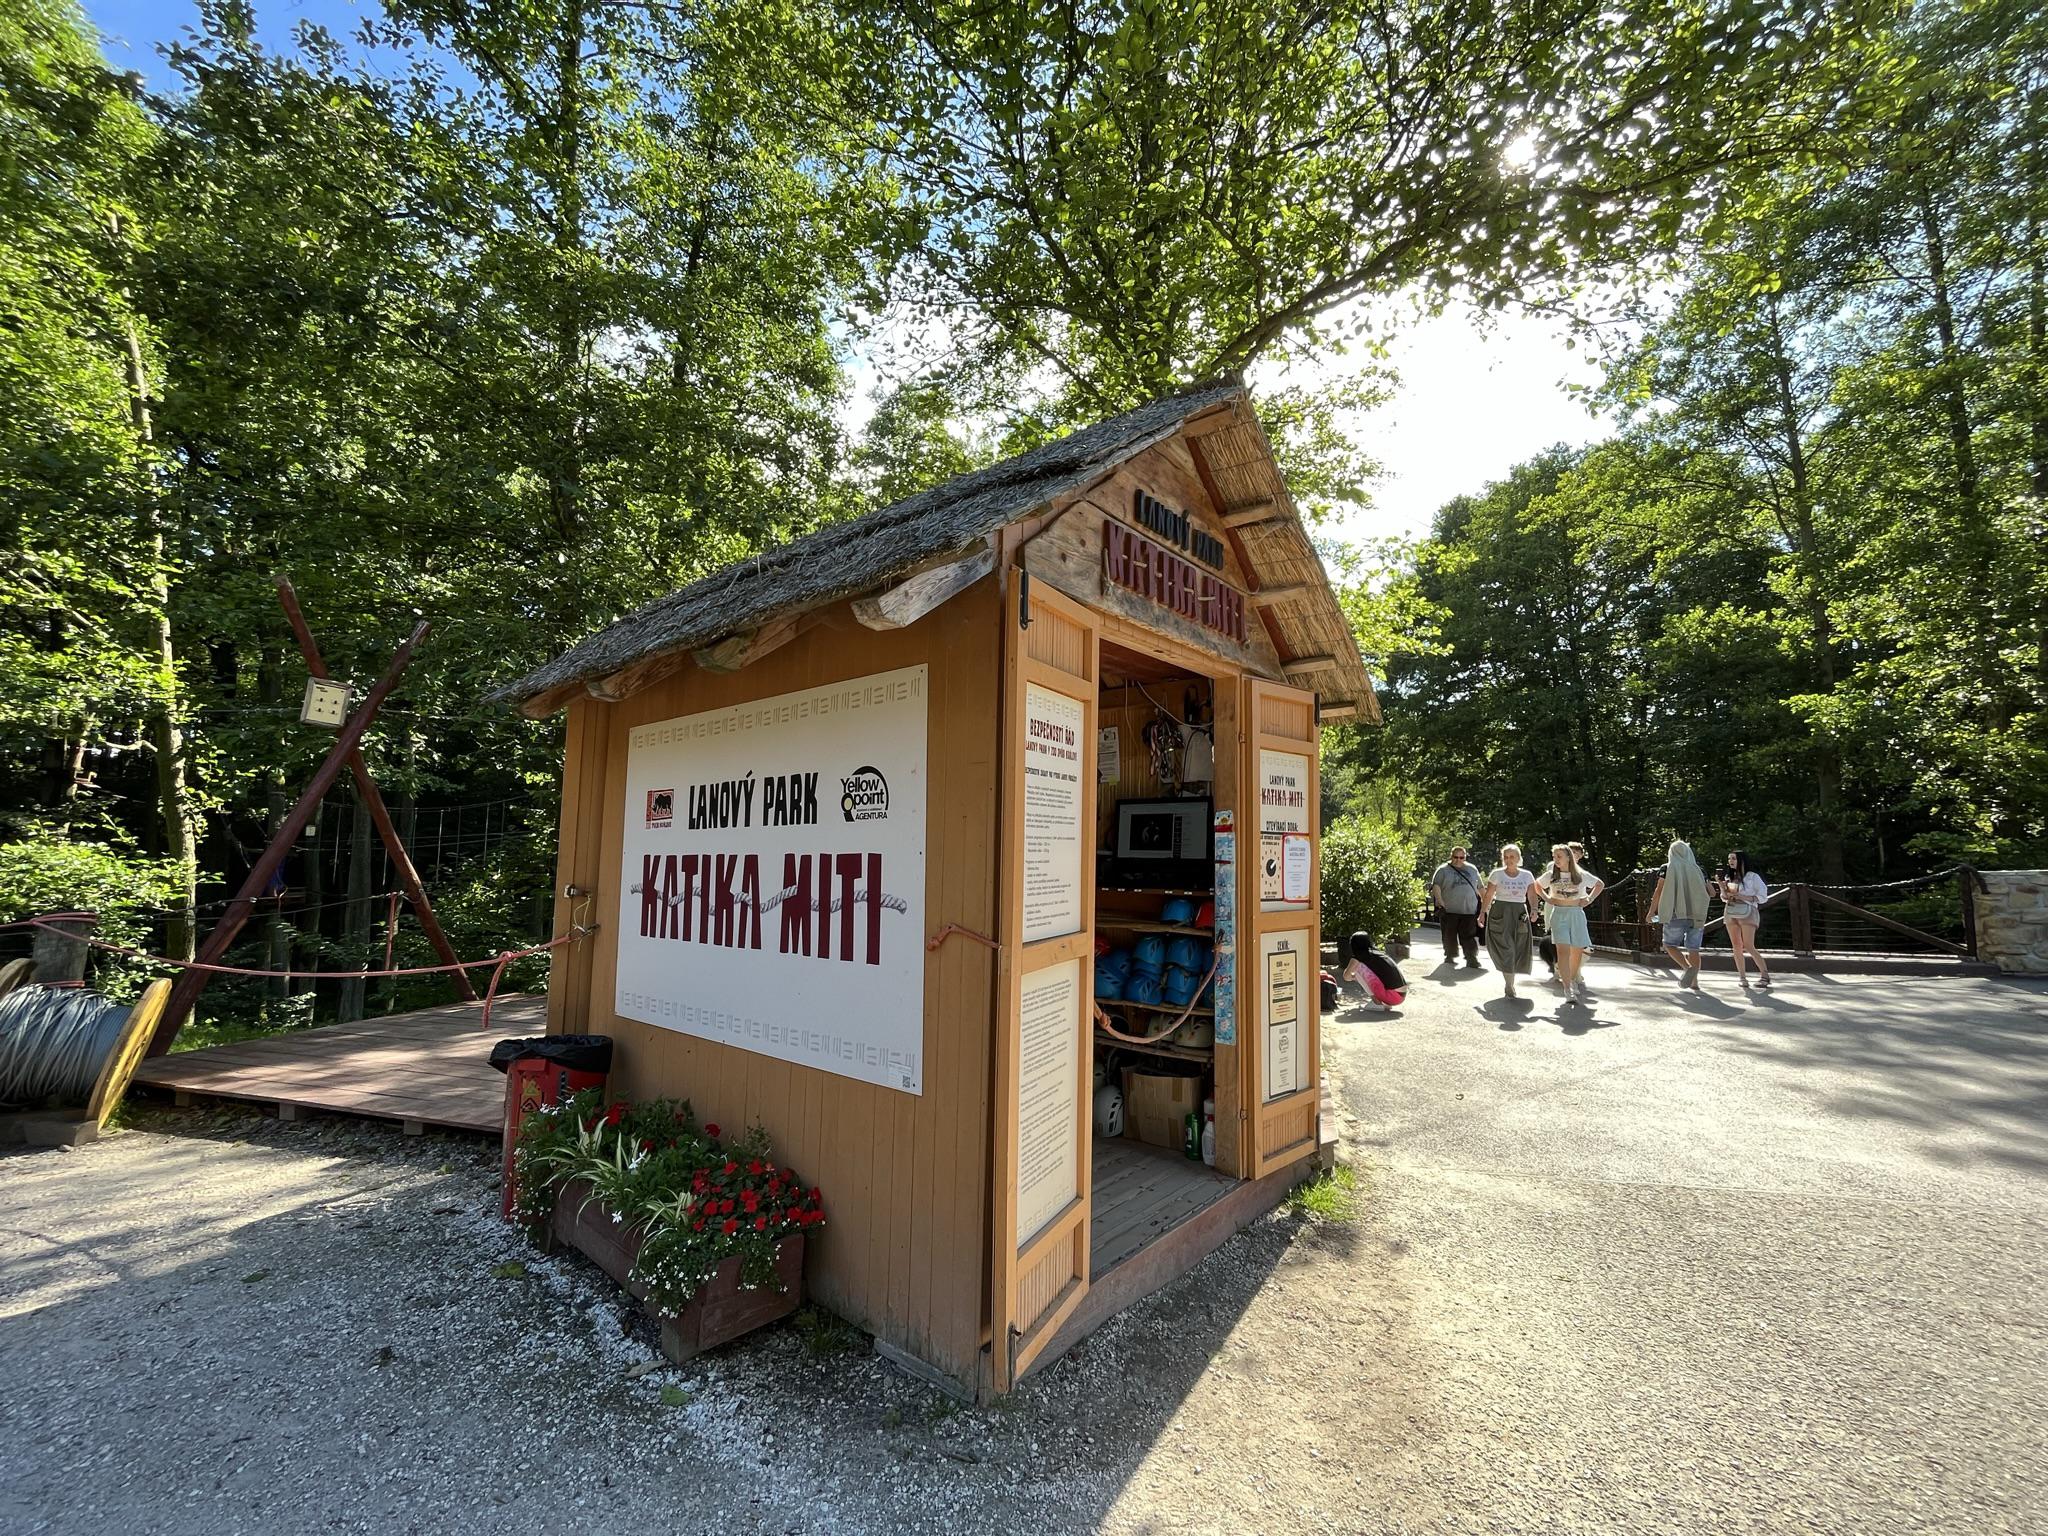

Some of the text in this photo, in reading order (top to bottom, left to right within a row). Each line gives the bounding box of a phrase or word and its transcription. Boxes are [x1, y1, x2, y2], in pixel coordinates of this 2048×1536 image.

[1103, 519, 1197, 620] KATIKA
[840, 776, 880, 793] Yellow
[1285, 776, 1296, 787] PARK
[688, 769, 819, 830] LANOVÝ PARK
[853, 788, 885, 809] point
[1261, 787, 1303, 808] KATIKA MITI
[855, 811, 888, 820] AGENTURA
[639, 852, 882, 965] KATIKA MITI
